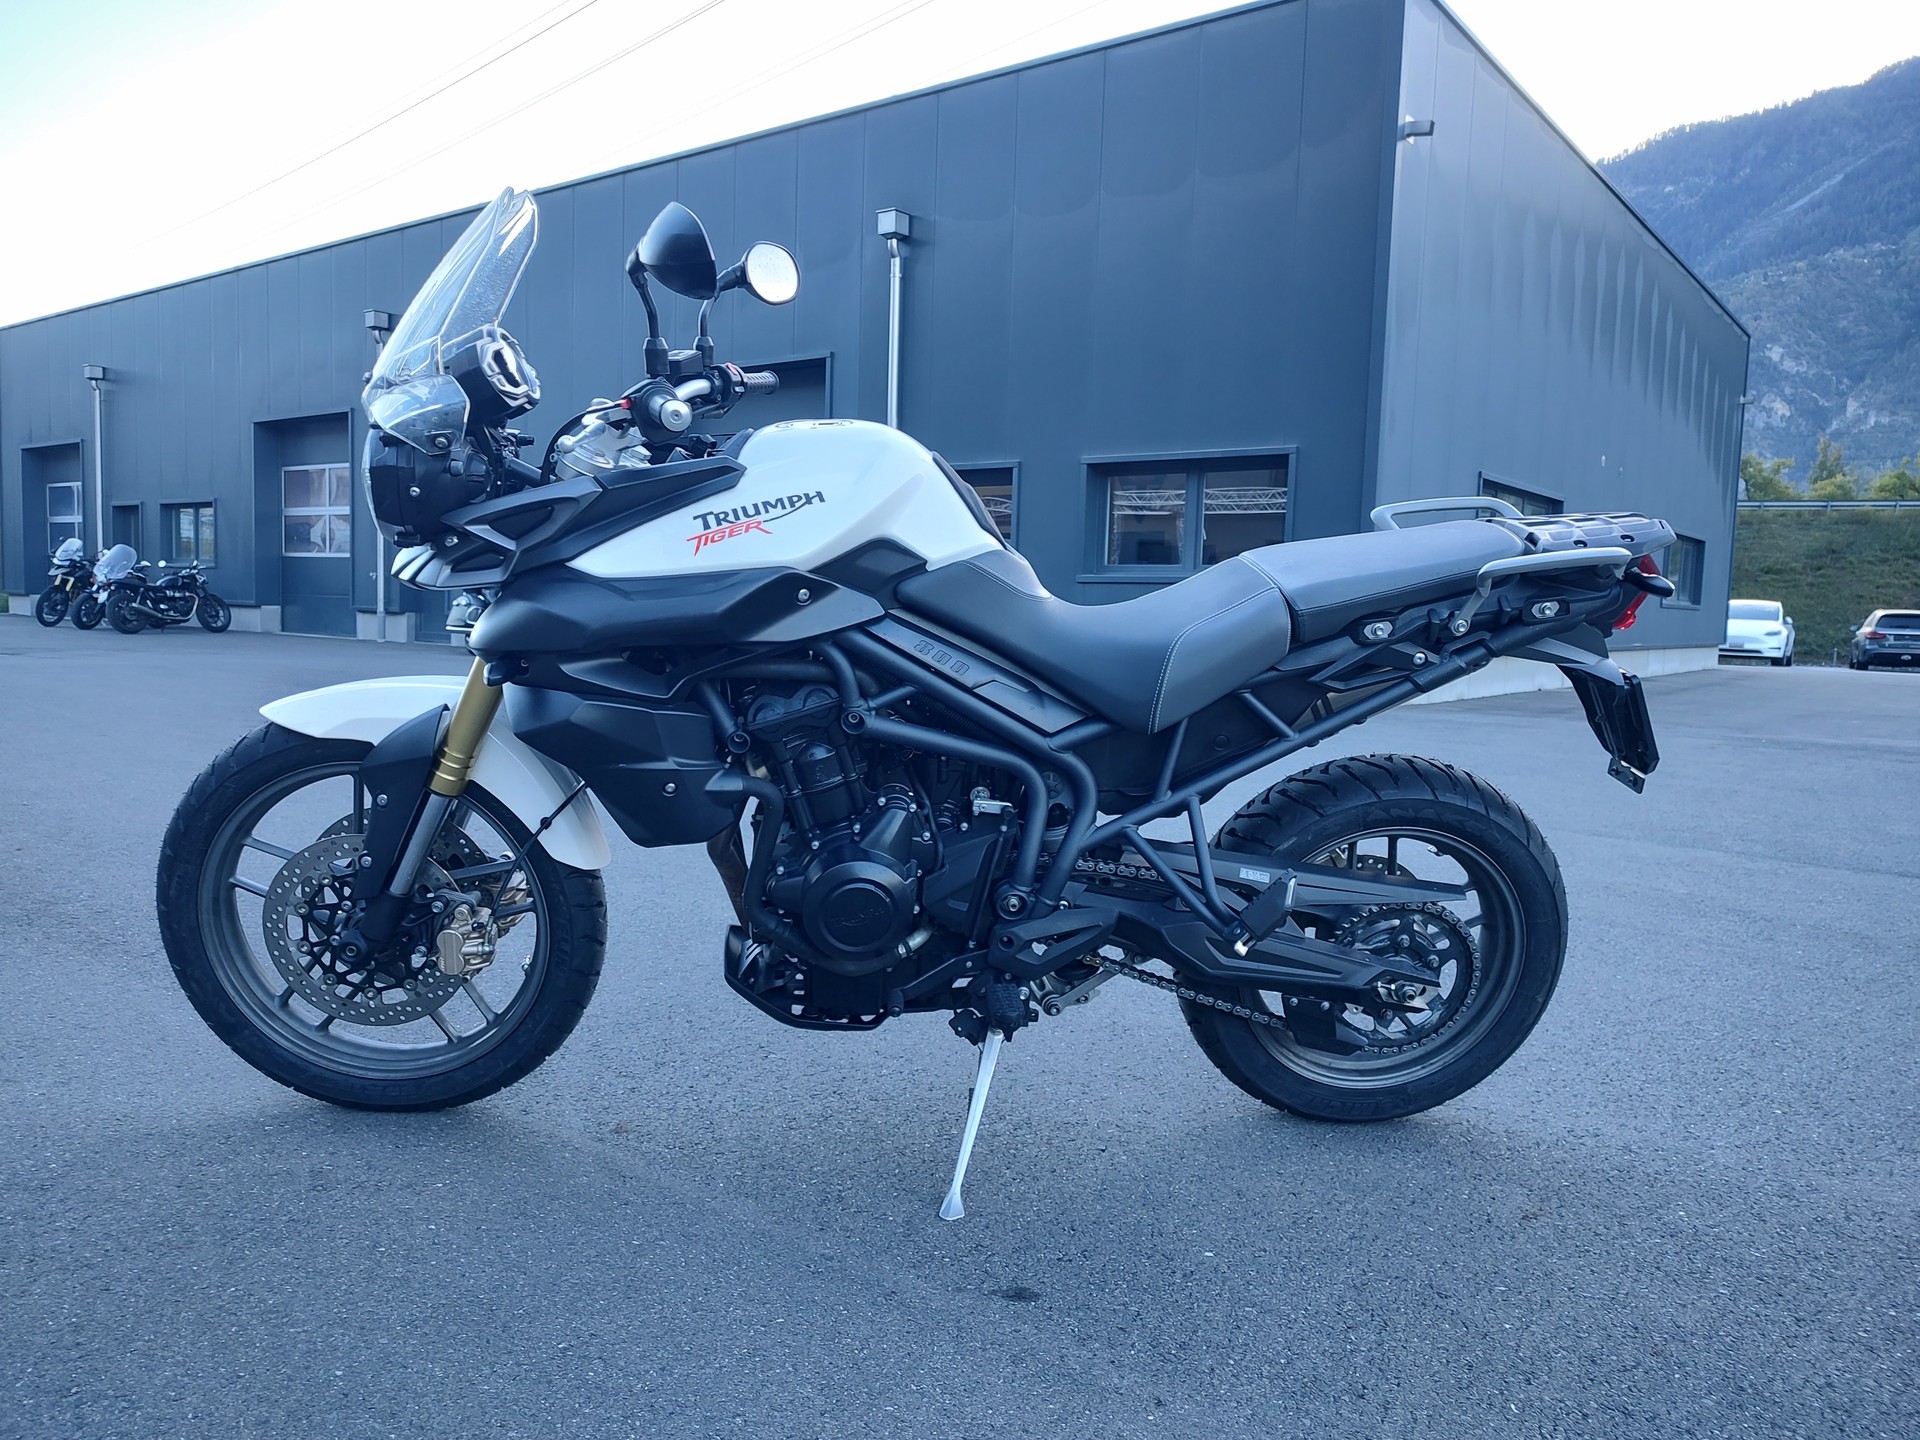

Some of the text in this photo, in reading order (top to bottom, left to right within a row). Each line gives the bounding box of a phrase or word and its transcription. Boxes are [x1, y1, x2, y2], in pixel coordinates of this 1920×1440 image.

[692, 490, 826, 532] TRIUMPH
[686, 518, 774, 557] TIGER
[913, 639, 971, 676] 800
